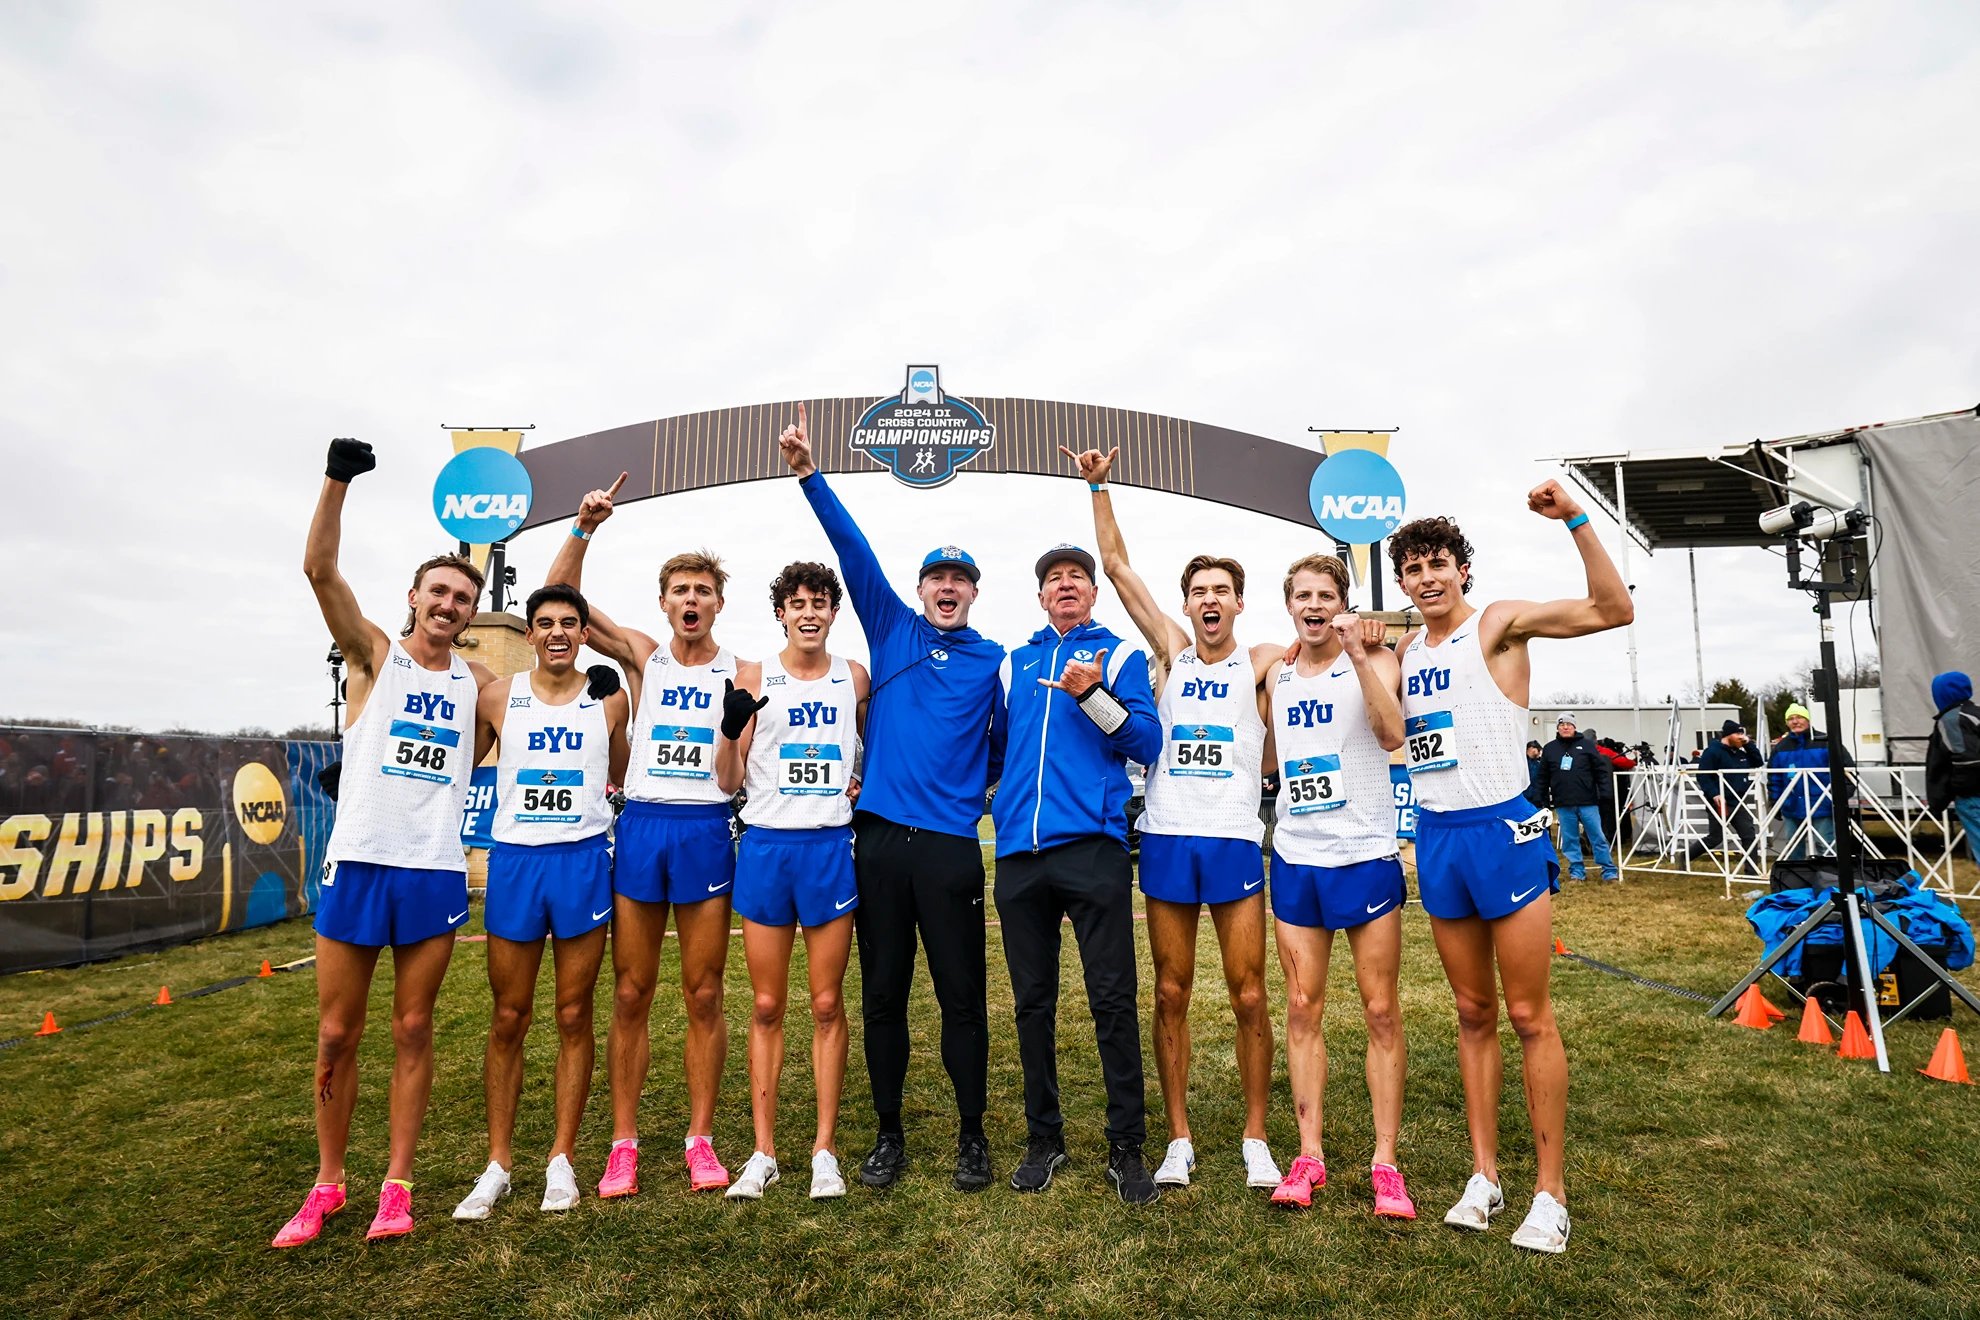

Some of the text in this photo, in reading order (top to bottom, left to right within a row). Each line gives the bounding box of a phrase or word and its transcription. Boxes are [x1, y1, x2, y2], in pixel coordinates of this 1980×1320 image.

[878, 419, 967, 427] CROSS COUNTRY
[894, 409, 951, 418] 2024 DI
[855, 429, 990, 445] CHAMPIONSHIPS
[441, 494, 528, 519] NCAA
[1320, 495, 1403, 519] NCAA
[1181, 677, 1229, 701] BYU
[1407, 667, 1451, 697] BYU
[404, 692, 456, 721] BYU
[661, 686, 712, 710] BYU
[788, 701, 837, 728] BYU
[1287, 699, 1334, 728] BYU
[528, 727, 583, 753] BYU
[1409, 733, 1444, 762] 552
[396, 741, 446, 771] 548
[657, 744, 702, 767] 544
[1178, 744, 1222, 766] 545
[789, 763, 830, 784] 551
[524, 789, 572, 811] 546
[1289, 776, 1333, 803] 553
[241, 800, 284, 824] NCAA
[0, 807, 204, 901] SHIPS
